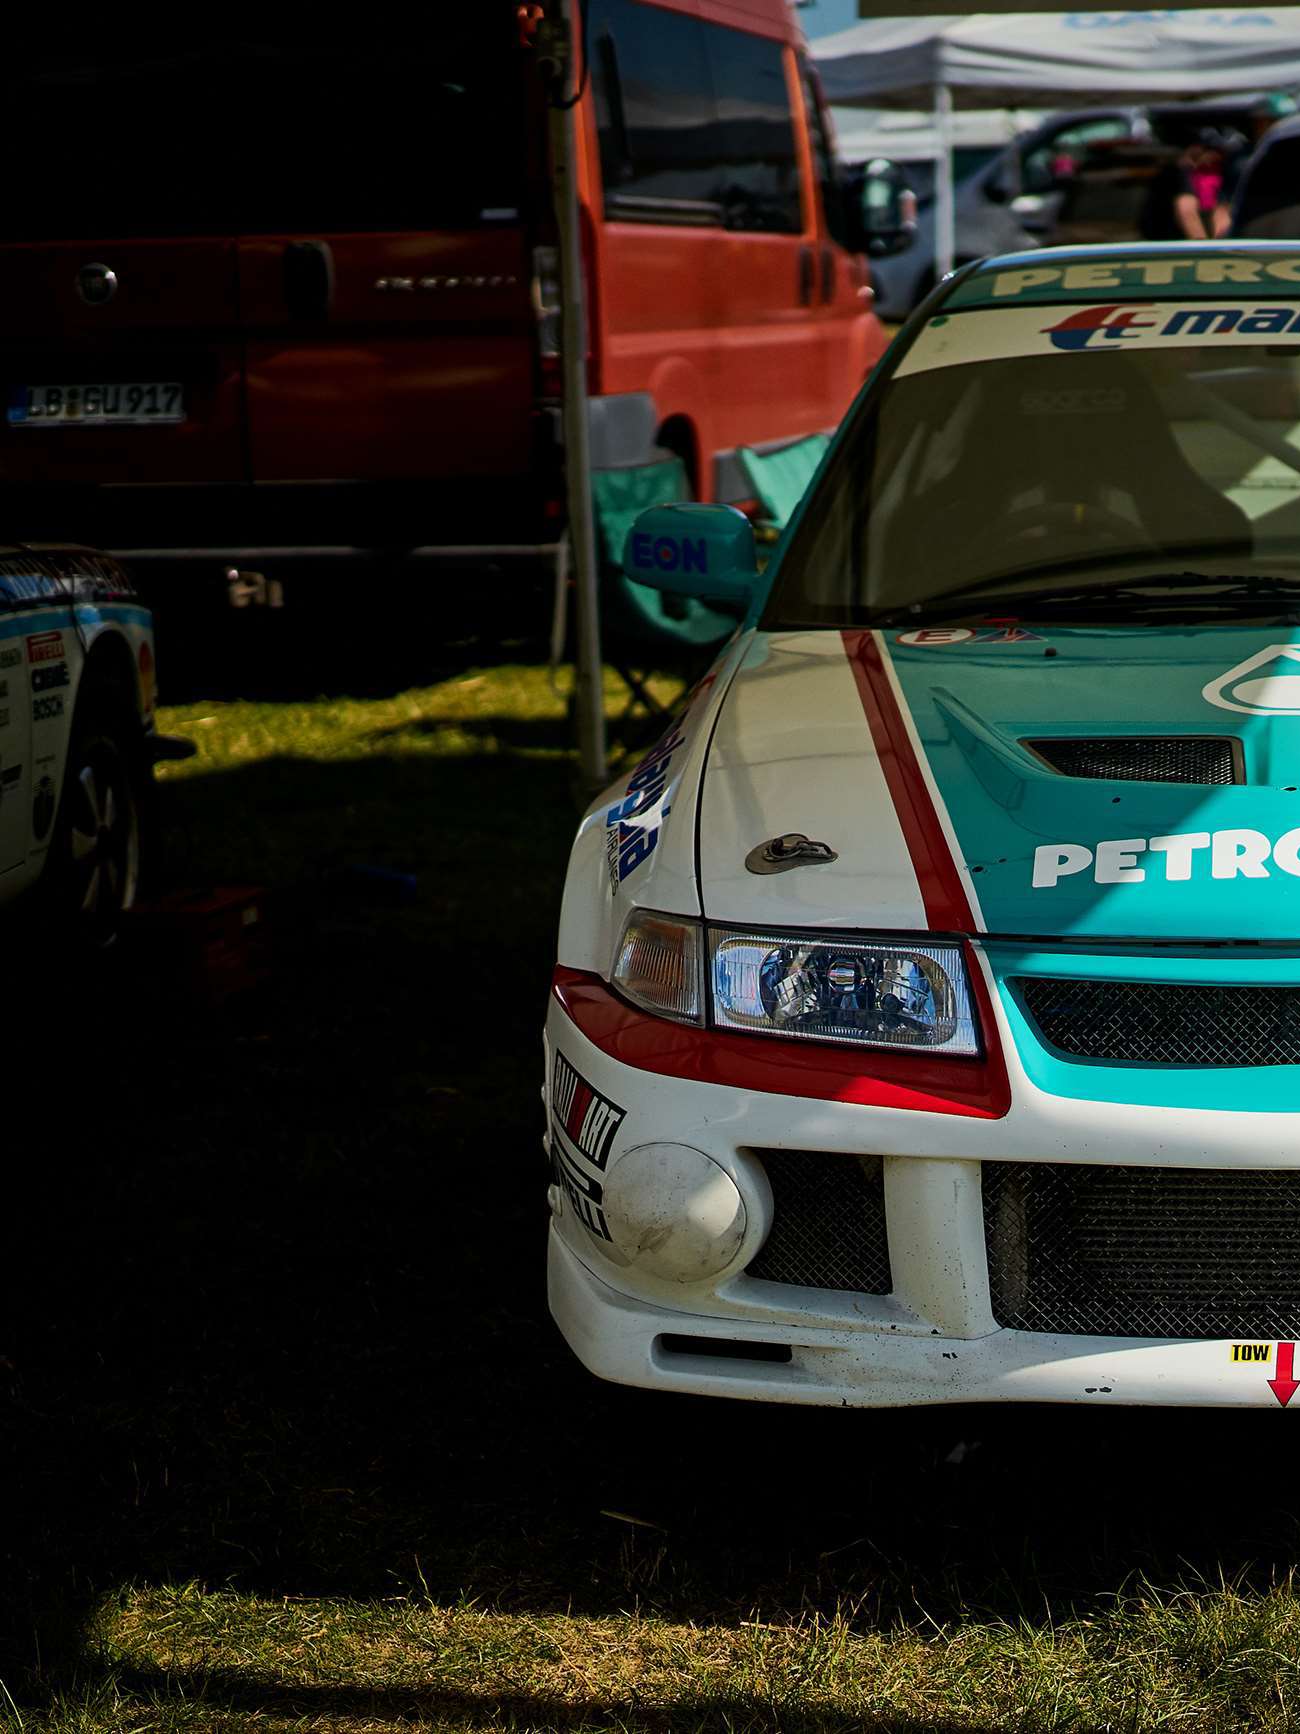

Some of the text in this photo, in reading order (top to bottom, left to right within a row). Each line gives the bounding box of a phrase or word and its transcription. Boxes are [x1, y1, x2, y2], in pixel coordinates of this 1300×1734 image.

[128, 384, 179, 414] 917
[633, 533, 707, 574] EON
[606, 826, 620, 897] AIRLINES
[1232, 1344, 1270, 1361] TOW
